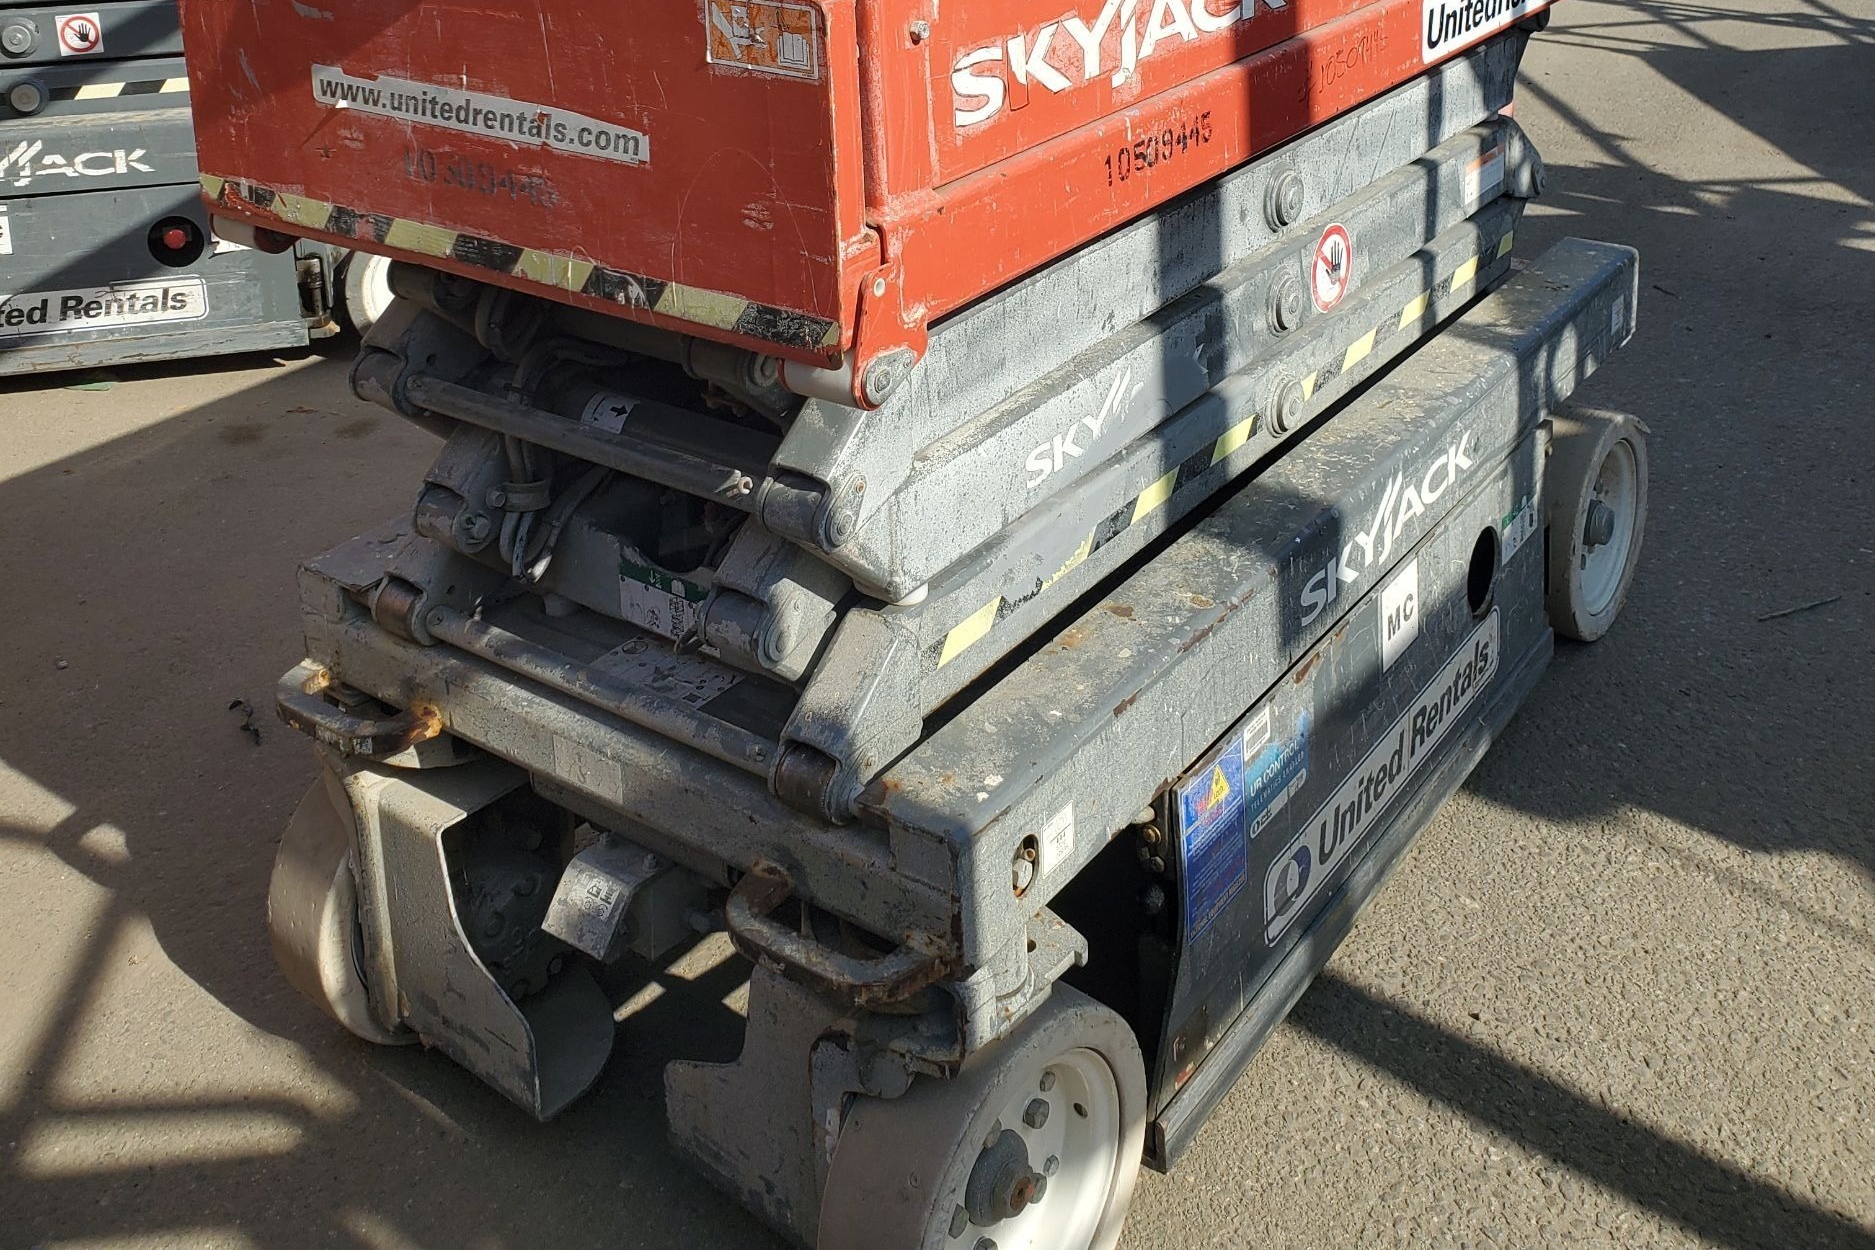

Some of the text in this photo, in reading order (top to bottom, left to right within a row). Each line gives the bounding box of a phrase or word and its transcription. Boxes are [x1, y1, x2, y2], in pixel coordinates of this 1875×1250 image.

[319, 78, 640, 156] www.unitedrentals.com
[1104, 111, 1213, 187] 10509445
[59, 287, 188, 322] Rentals
[1300, 430, 1473, 627] SKYJACK
[1387, 593, 1414, 642] MC
[1250, 779, 1263, 797] UR
[1263, 739, 1299, 780] CONTROL
[1318, 637, 1490, 867] United Rentals
